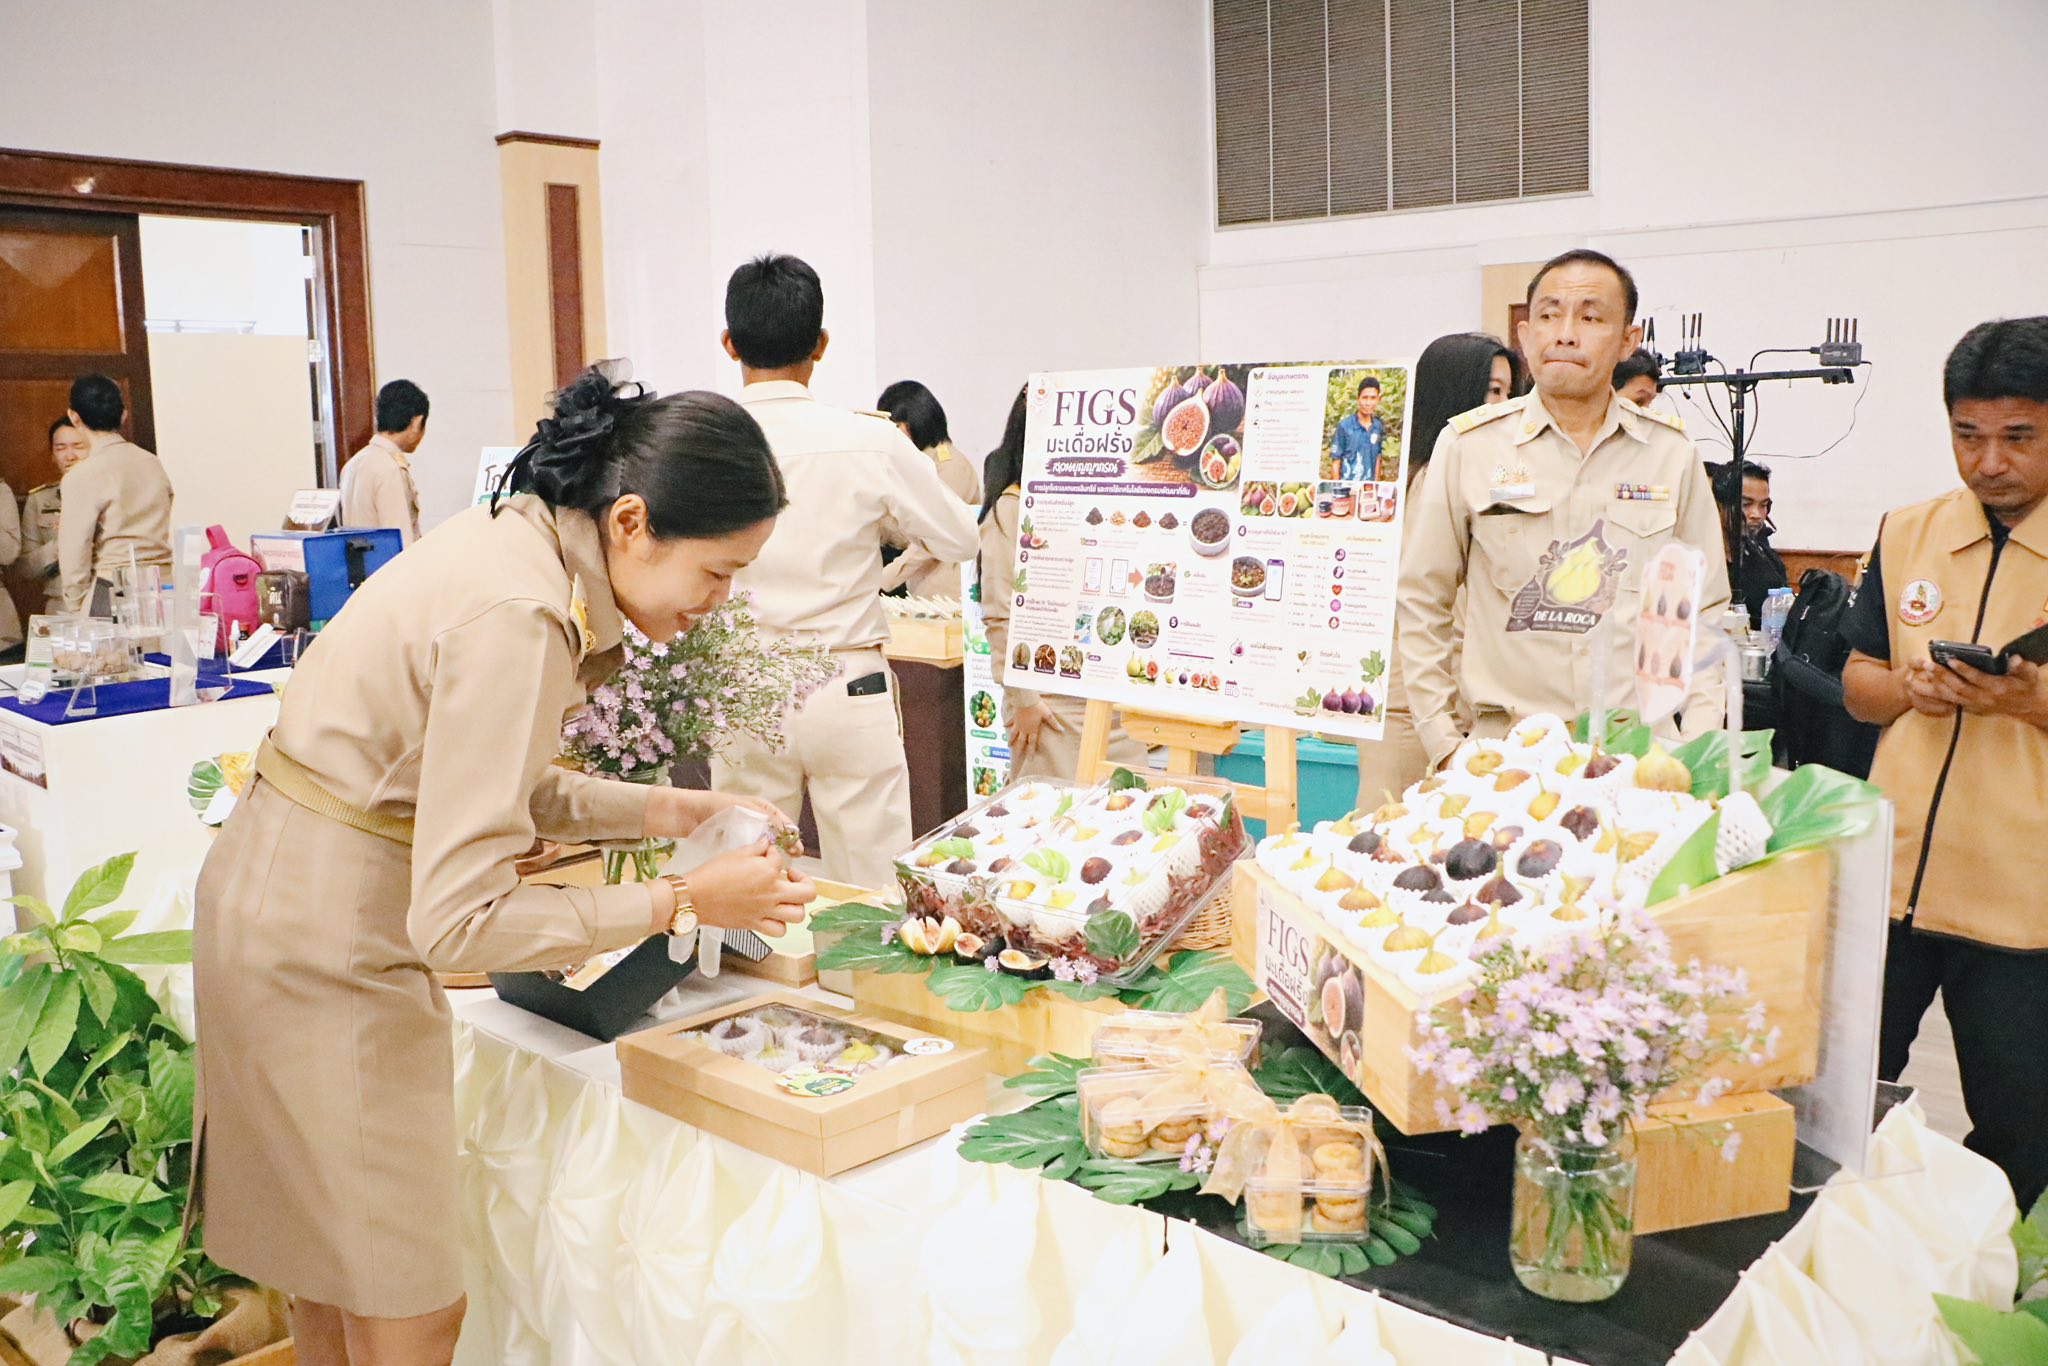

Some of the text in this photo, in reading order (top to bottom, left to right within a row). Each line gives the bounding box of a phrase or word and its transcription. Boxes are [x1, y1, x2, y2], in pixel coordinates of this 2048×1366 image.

[1053, 388, 1136, 427] FIGS
[1046, 427, 1133, 454] มะเดื่อฝรั่ง
[1533, 610, 1549, 621] DE
[1548, 611, 1563, 622] LA
[1268, 910, 1309, 976] FIGS
